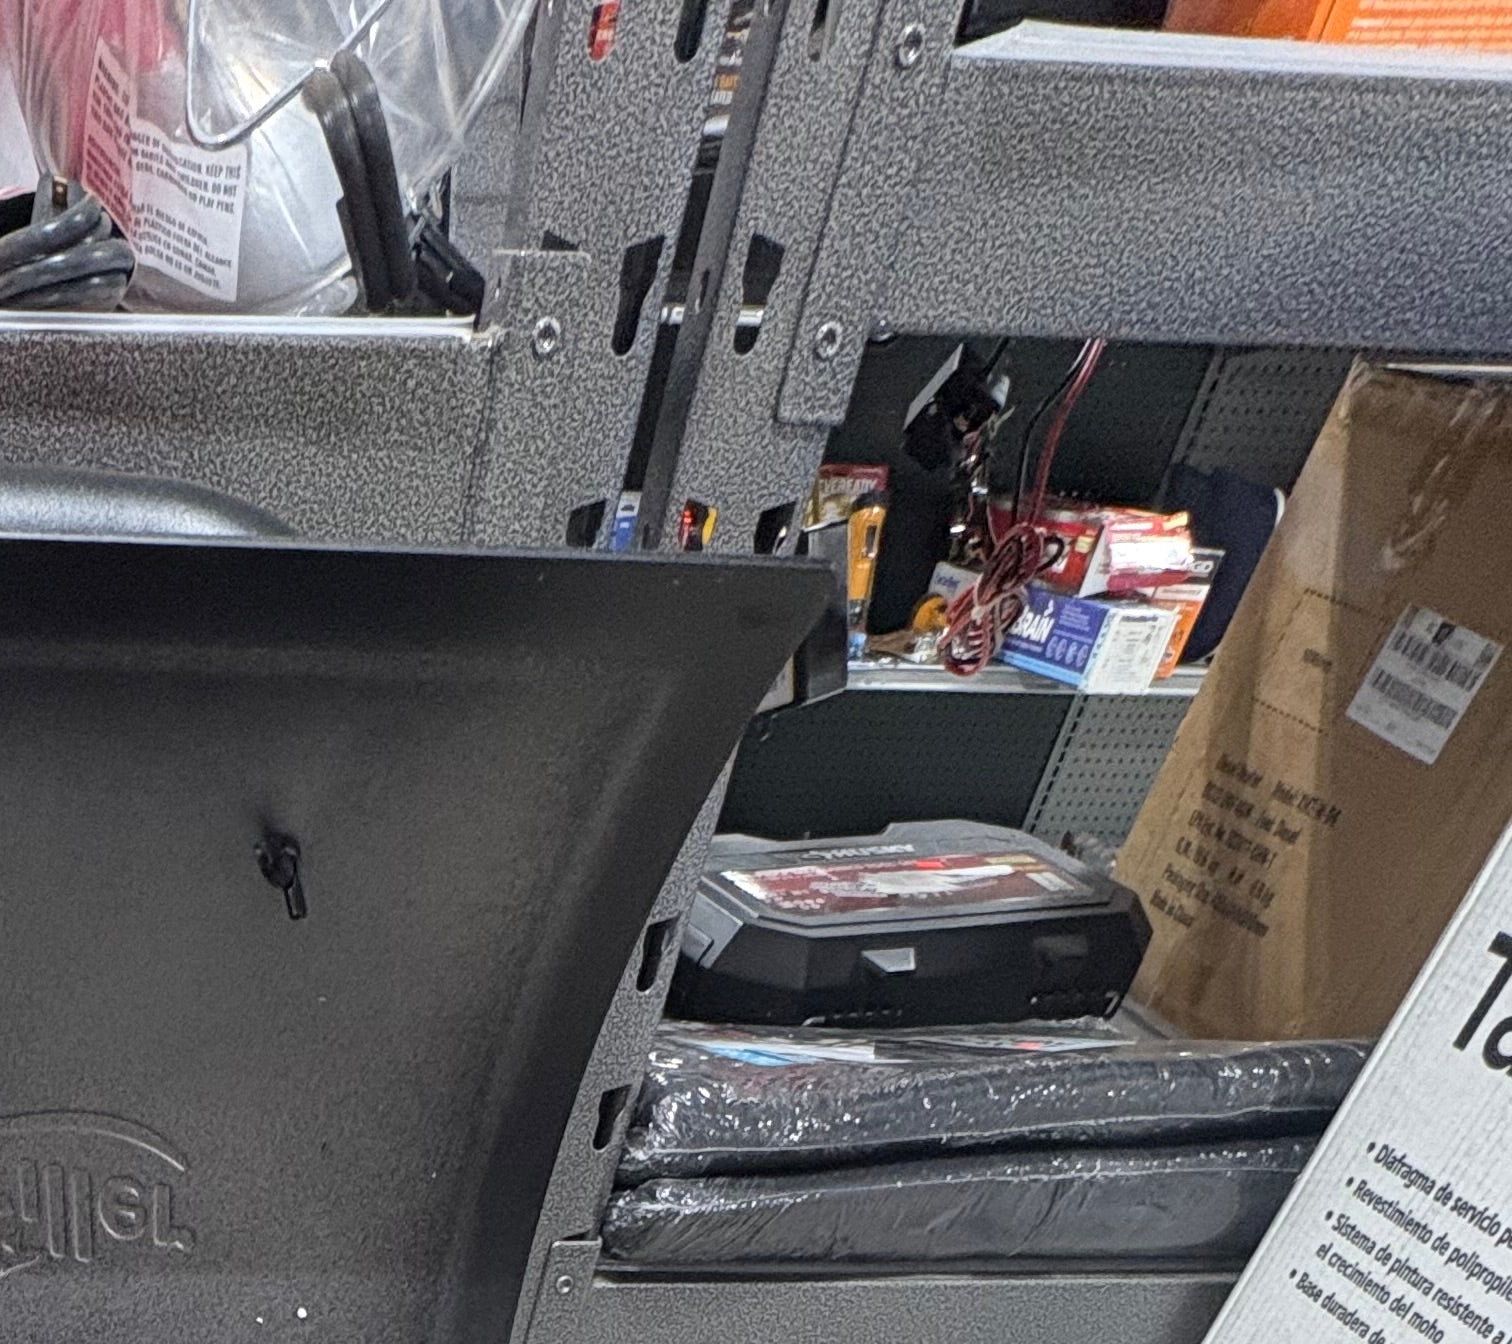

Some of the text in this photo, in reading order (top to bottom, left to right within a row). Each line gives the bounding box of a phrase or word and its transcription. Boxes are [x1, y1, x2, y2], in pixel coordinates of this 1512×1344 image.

[1352, 1179, 1433, 1244] Revestimiento
[1431, 1232, 1450, 1256] de
[1374, 1144, 1436, 1196] Diafragma
[1433, 1182, 1453, 1207] de
[1449, 1196, 1501, 1237] servicio
[1295, 1272, 1323, 1303] Base
[1321, 1292, 1370, 1339] duradera
[1316, 1242, 1444, 1344] el crecimiento del moho
[1331, 1213, 1377, 1255] Sistema
[1374, 1244, 1392, 1266] de
[1386, 1257, 1435, 1296] pintura
[1431, 1288, 1494, 1339] resistente
